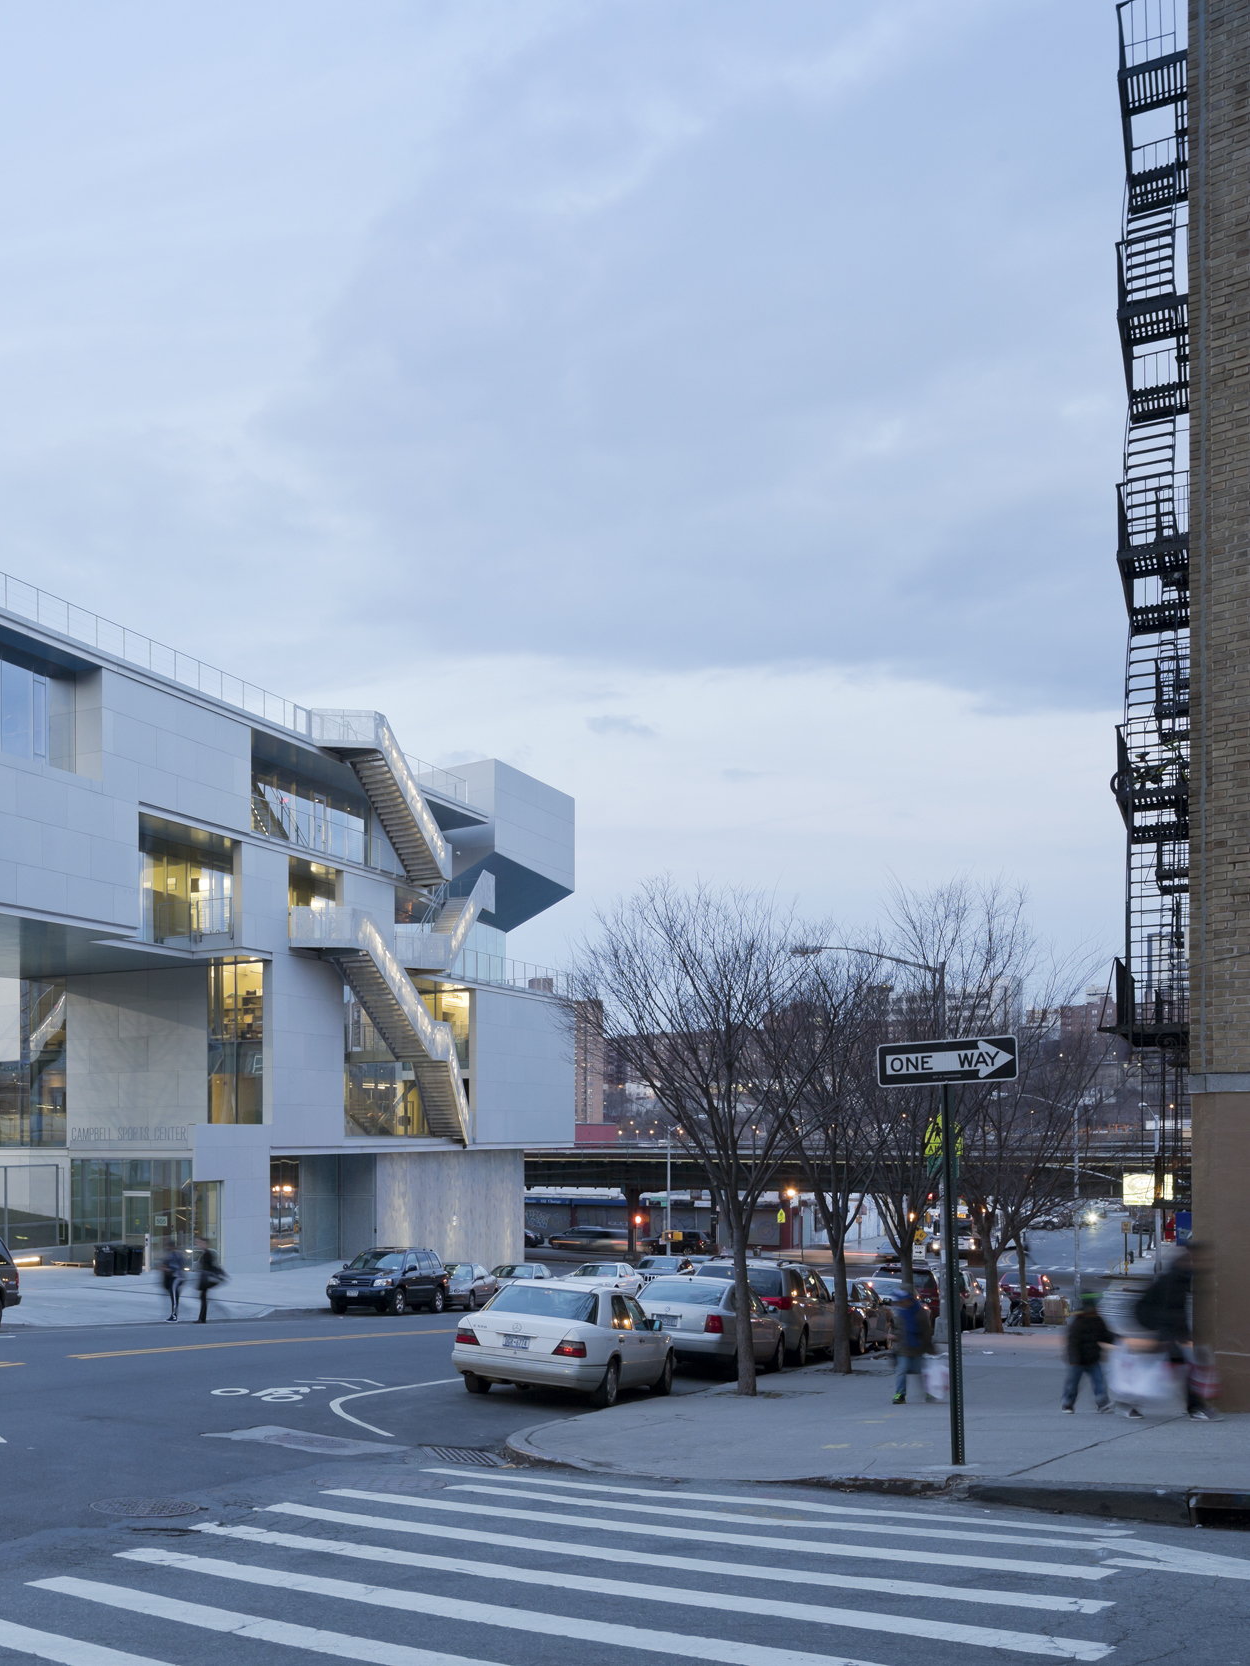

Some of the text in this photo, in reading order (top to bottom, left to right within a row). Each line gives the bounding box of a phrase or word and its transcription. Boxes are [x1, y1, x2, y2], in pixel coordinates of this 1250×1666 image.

[890, 1051, 1000, 1073] ONE WAY
[71, 1126, 187, 1141] CAMPBELL SPORTS CENTER
